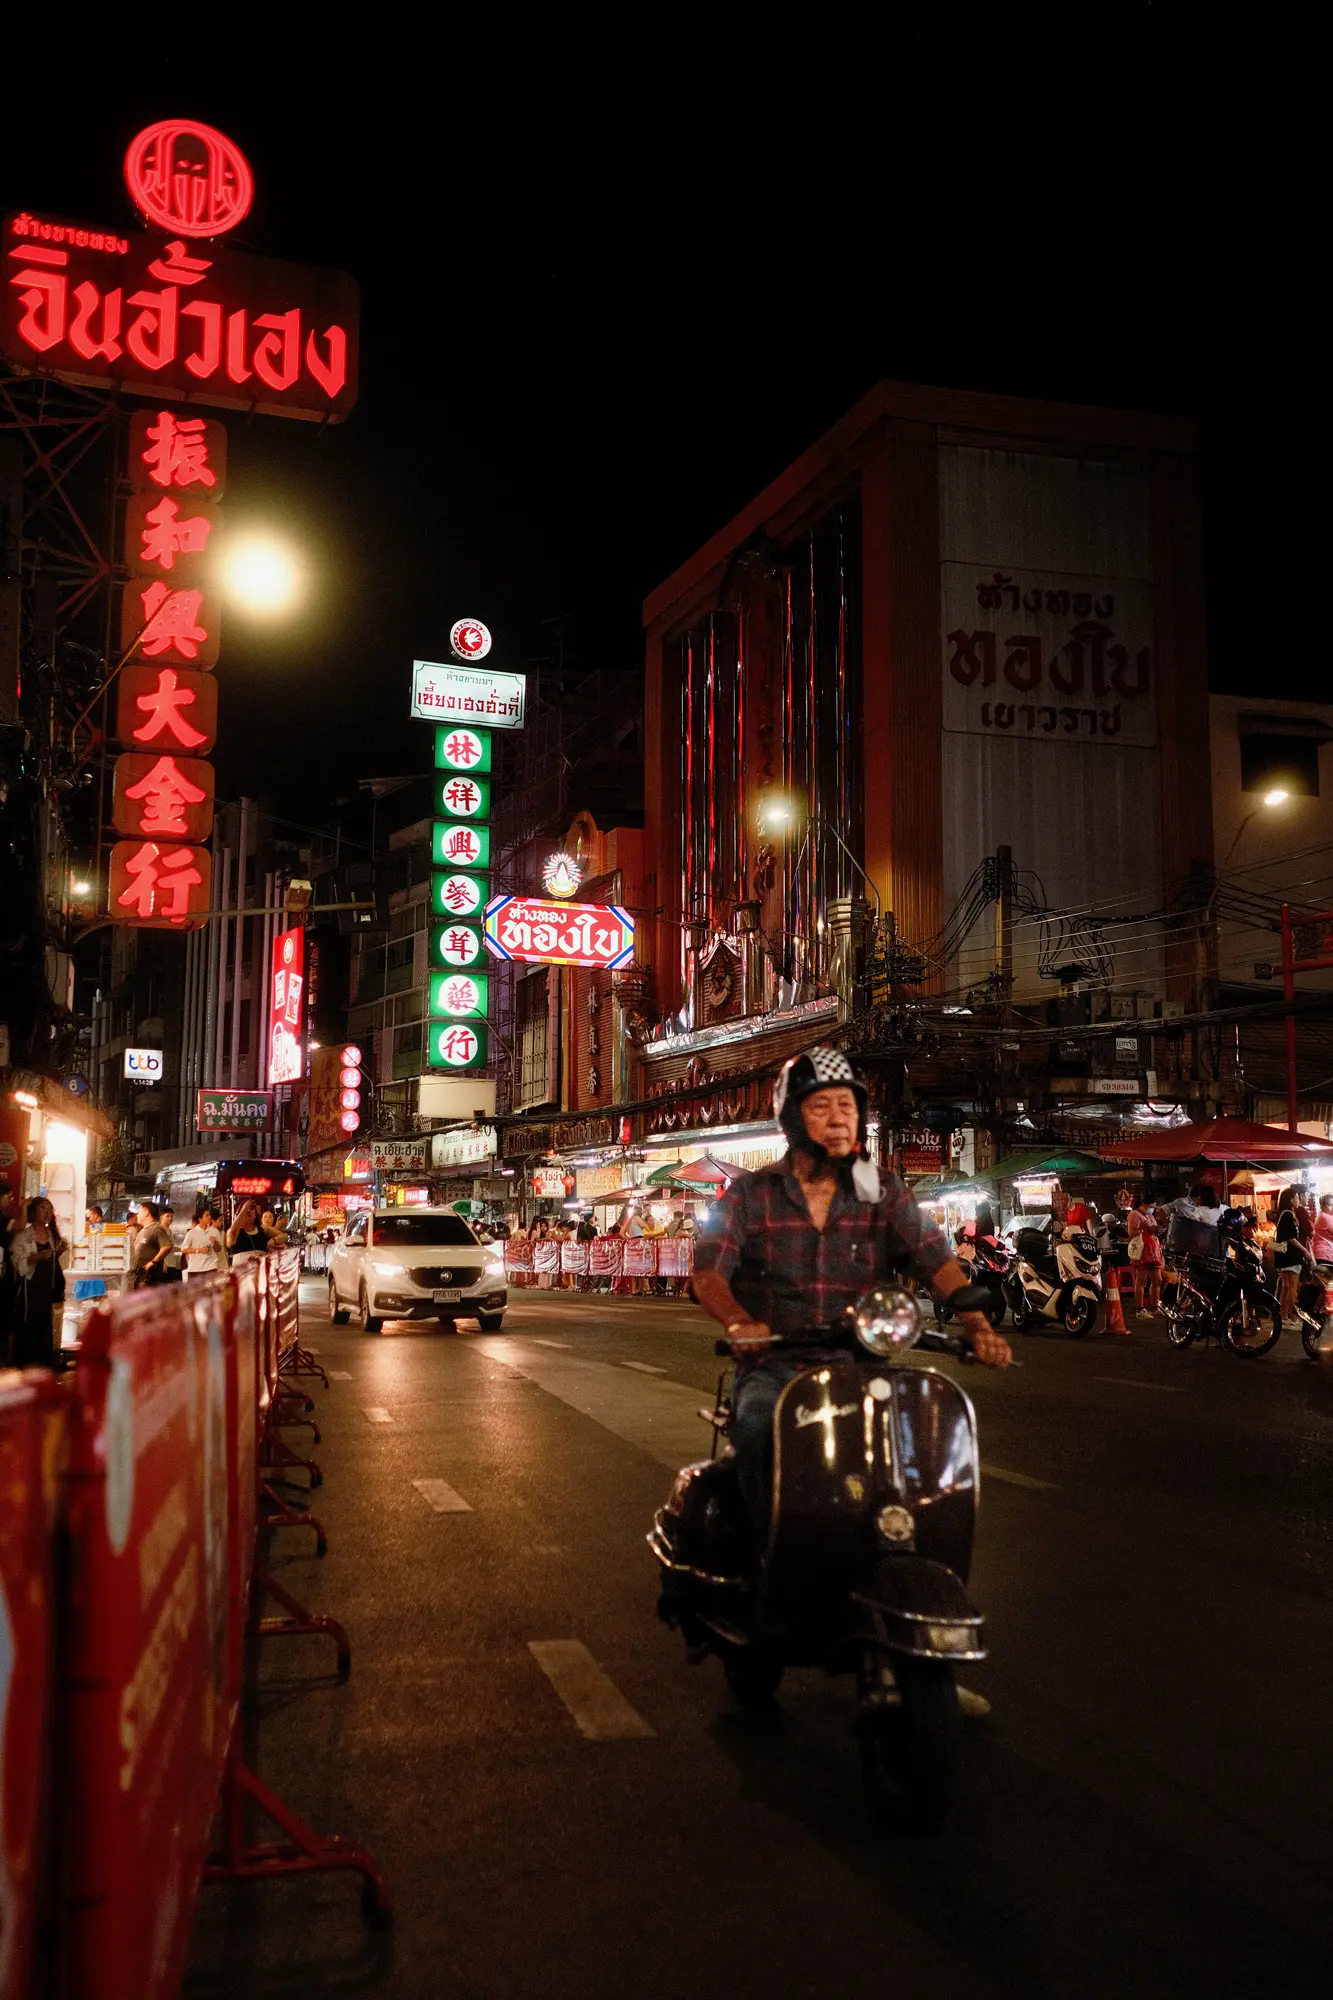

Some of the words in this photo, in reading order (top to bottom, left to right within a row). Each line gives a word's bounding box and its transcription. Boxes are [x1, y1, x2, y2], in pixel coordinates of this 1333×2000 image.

[118, 410, 217, 923] 振和興大金行
[947, 620, 1151, 699] ทองใบ
[981, 701, 1122, 736] เยาวราช
[508, 903, 567, 924] ห้างทอง
[500, 913, 620, 958] ทองใบ
[129, 1054, 159, 1070] ttb
[69, 1079, 77, 1091] 6
[283, 1178, 293, 1193] 4
[1081, 1242, 1097, 1252] 601
